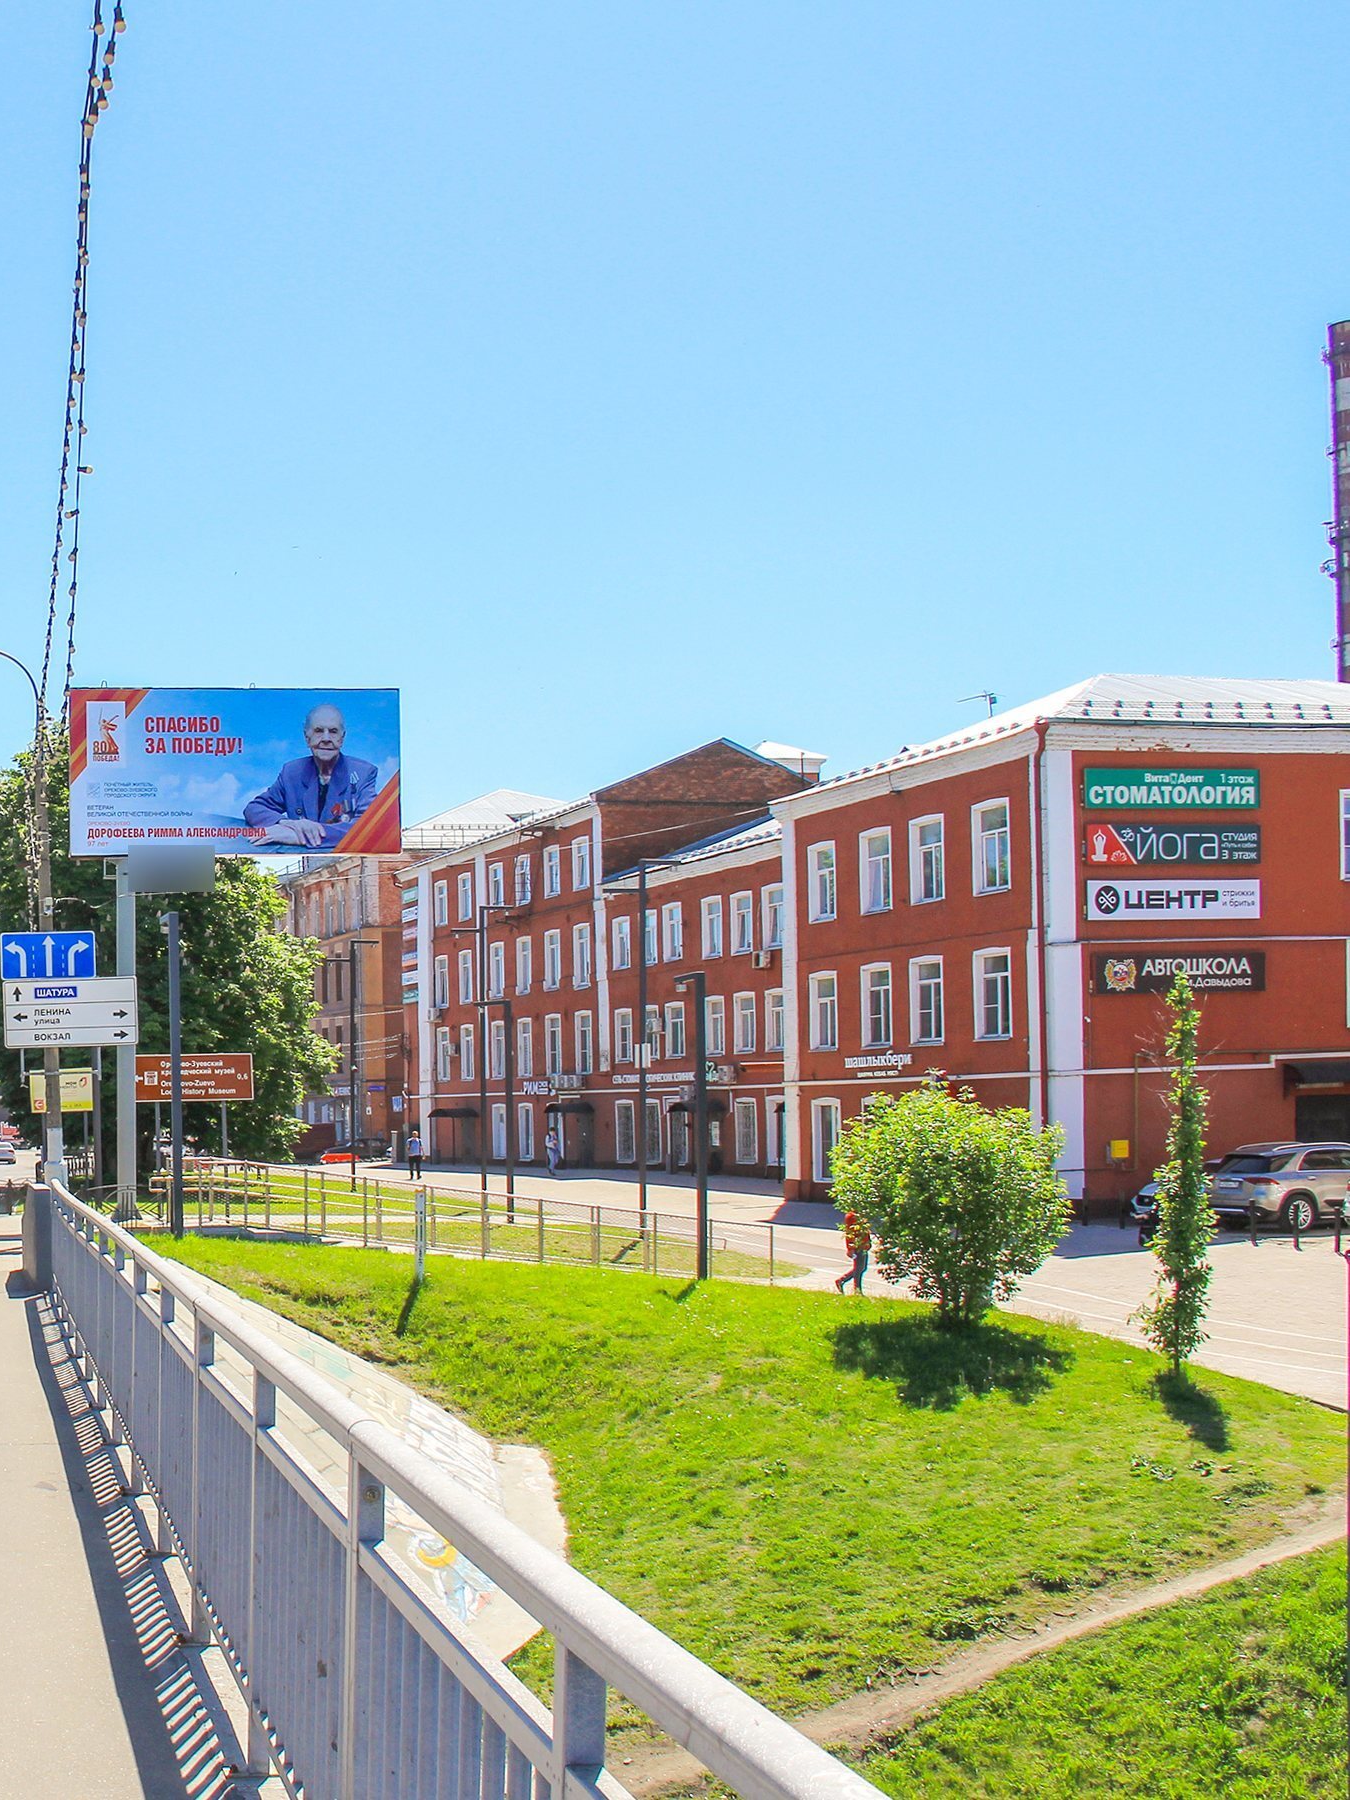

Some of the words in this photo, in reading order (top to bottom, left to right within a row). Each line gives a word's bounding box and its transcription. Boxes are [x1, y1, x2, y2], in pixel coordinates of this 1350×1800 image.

[144, 716, 220, 733] СПАСИБО
[92, 740, 108, 754] 80
[144, 737, 167, 754] ЗА
[171, 737, 243, 756] ПОБЕДУ!
[92, 754, 120, 762] ПОБЕДА!
[1219, 773, 1226, 783] 1
[1228, 775, 1254, 784] этаж
[1089, 785, 1255, 805] СТОМАТОЛОГИЯ
[87, 827, 145, 840] ДОРОФЕЕВА
[147, 827, 184, 838] РИММА
[186, 827, 267, 839] АЛЕКСАНДРОВНА
[1221, 832, 1258, 841] СТУДИЯ
[1221, 850, 1229, 860] 3
[1232, 851, 1258, 860] этаж
[1221, 889, 1255, 899] стрижки
[1124, 889, 1219, 910] ЦЕНТР
[1228, 898, 1256, 908] бритья
[1141, 956, 1252, 977] АВТОШКОЛА
[1186, 976, 1252, 988] м.Давыдова
[35, 988, 75, 997] ШАТУРА
[33, 1008, 71, 1017] ЛЕНИНА
[33, 1018, 61, 1026] улица
[34, 1032, 71, 1041] ВОКЗАЛ
[844, 1050, 913, 1070] шашлыкбери
[213, 1067, 235, 1075] музей
[181, 1088, 206, 1096] History
[208, 1087, 237, 1095] Museum
